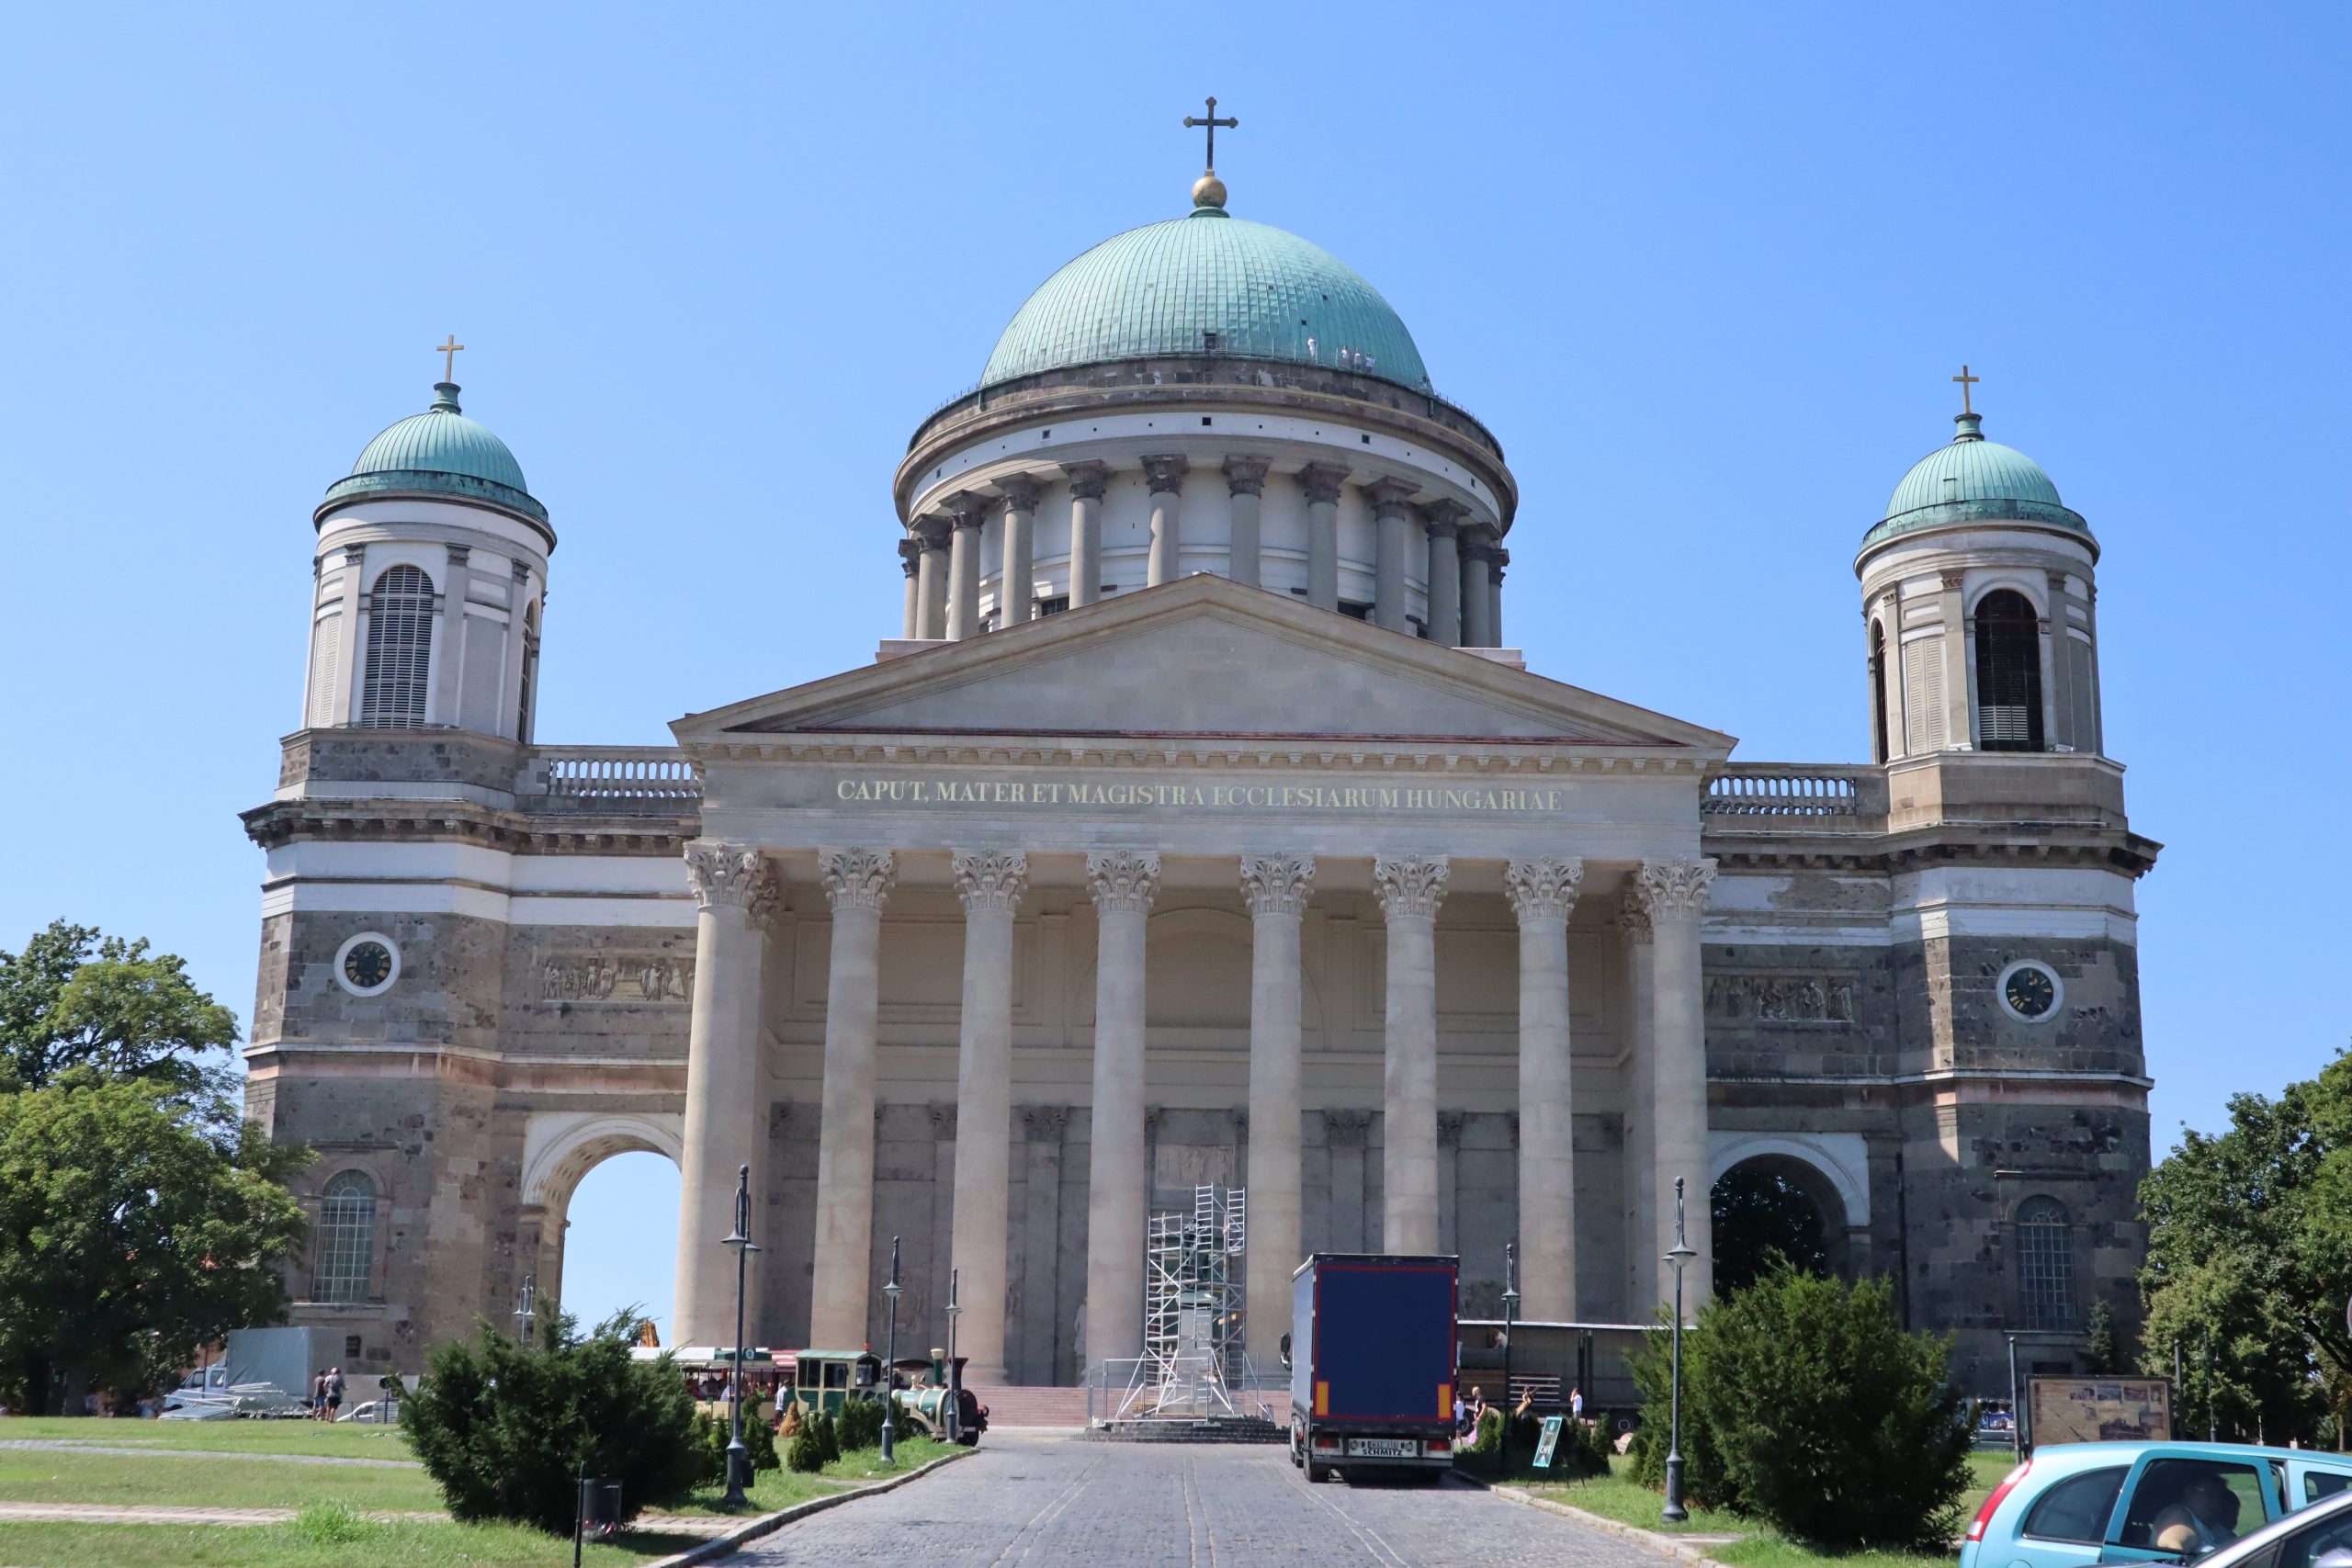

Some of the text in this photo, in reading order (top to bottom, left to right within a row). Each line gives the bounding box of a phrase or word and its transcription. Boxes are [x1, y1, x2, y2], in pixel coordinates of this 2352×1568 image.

[837, 780, 1563, 810] CAPUT, MATER ET MAGISTRA ECCLESIARUM HUNGARIAE
